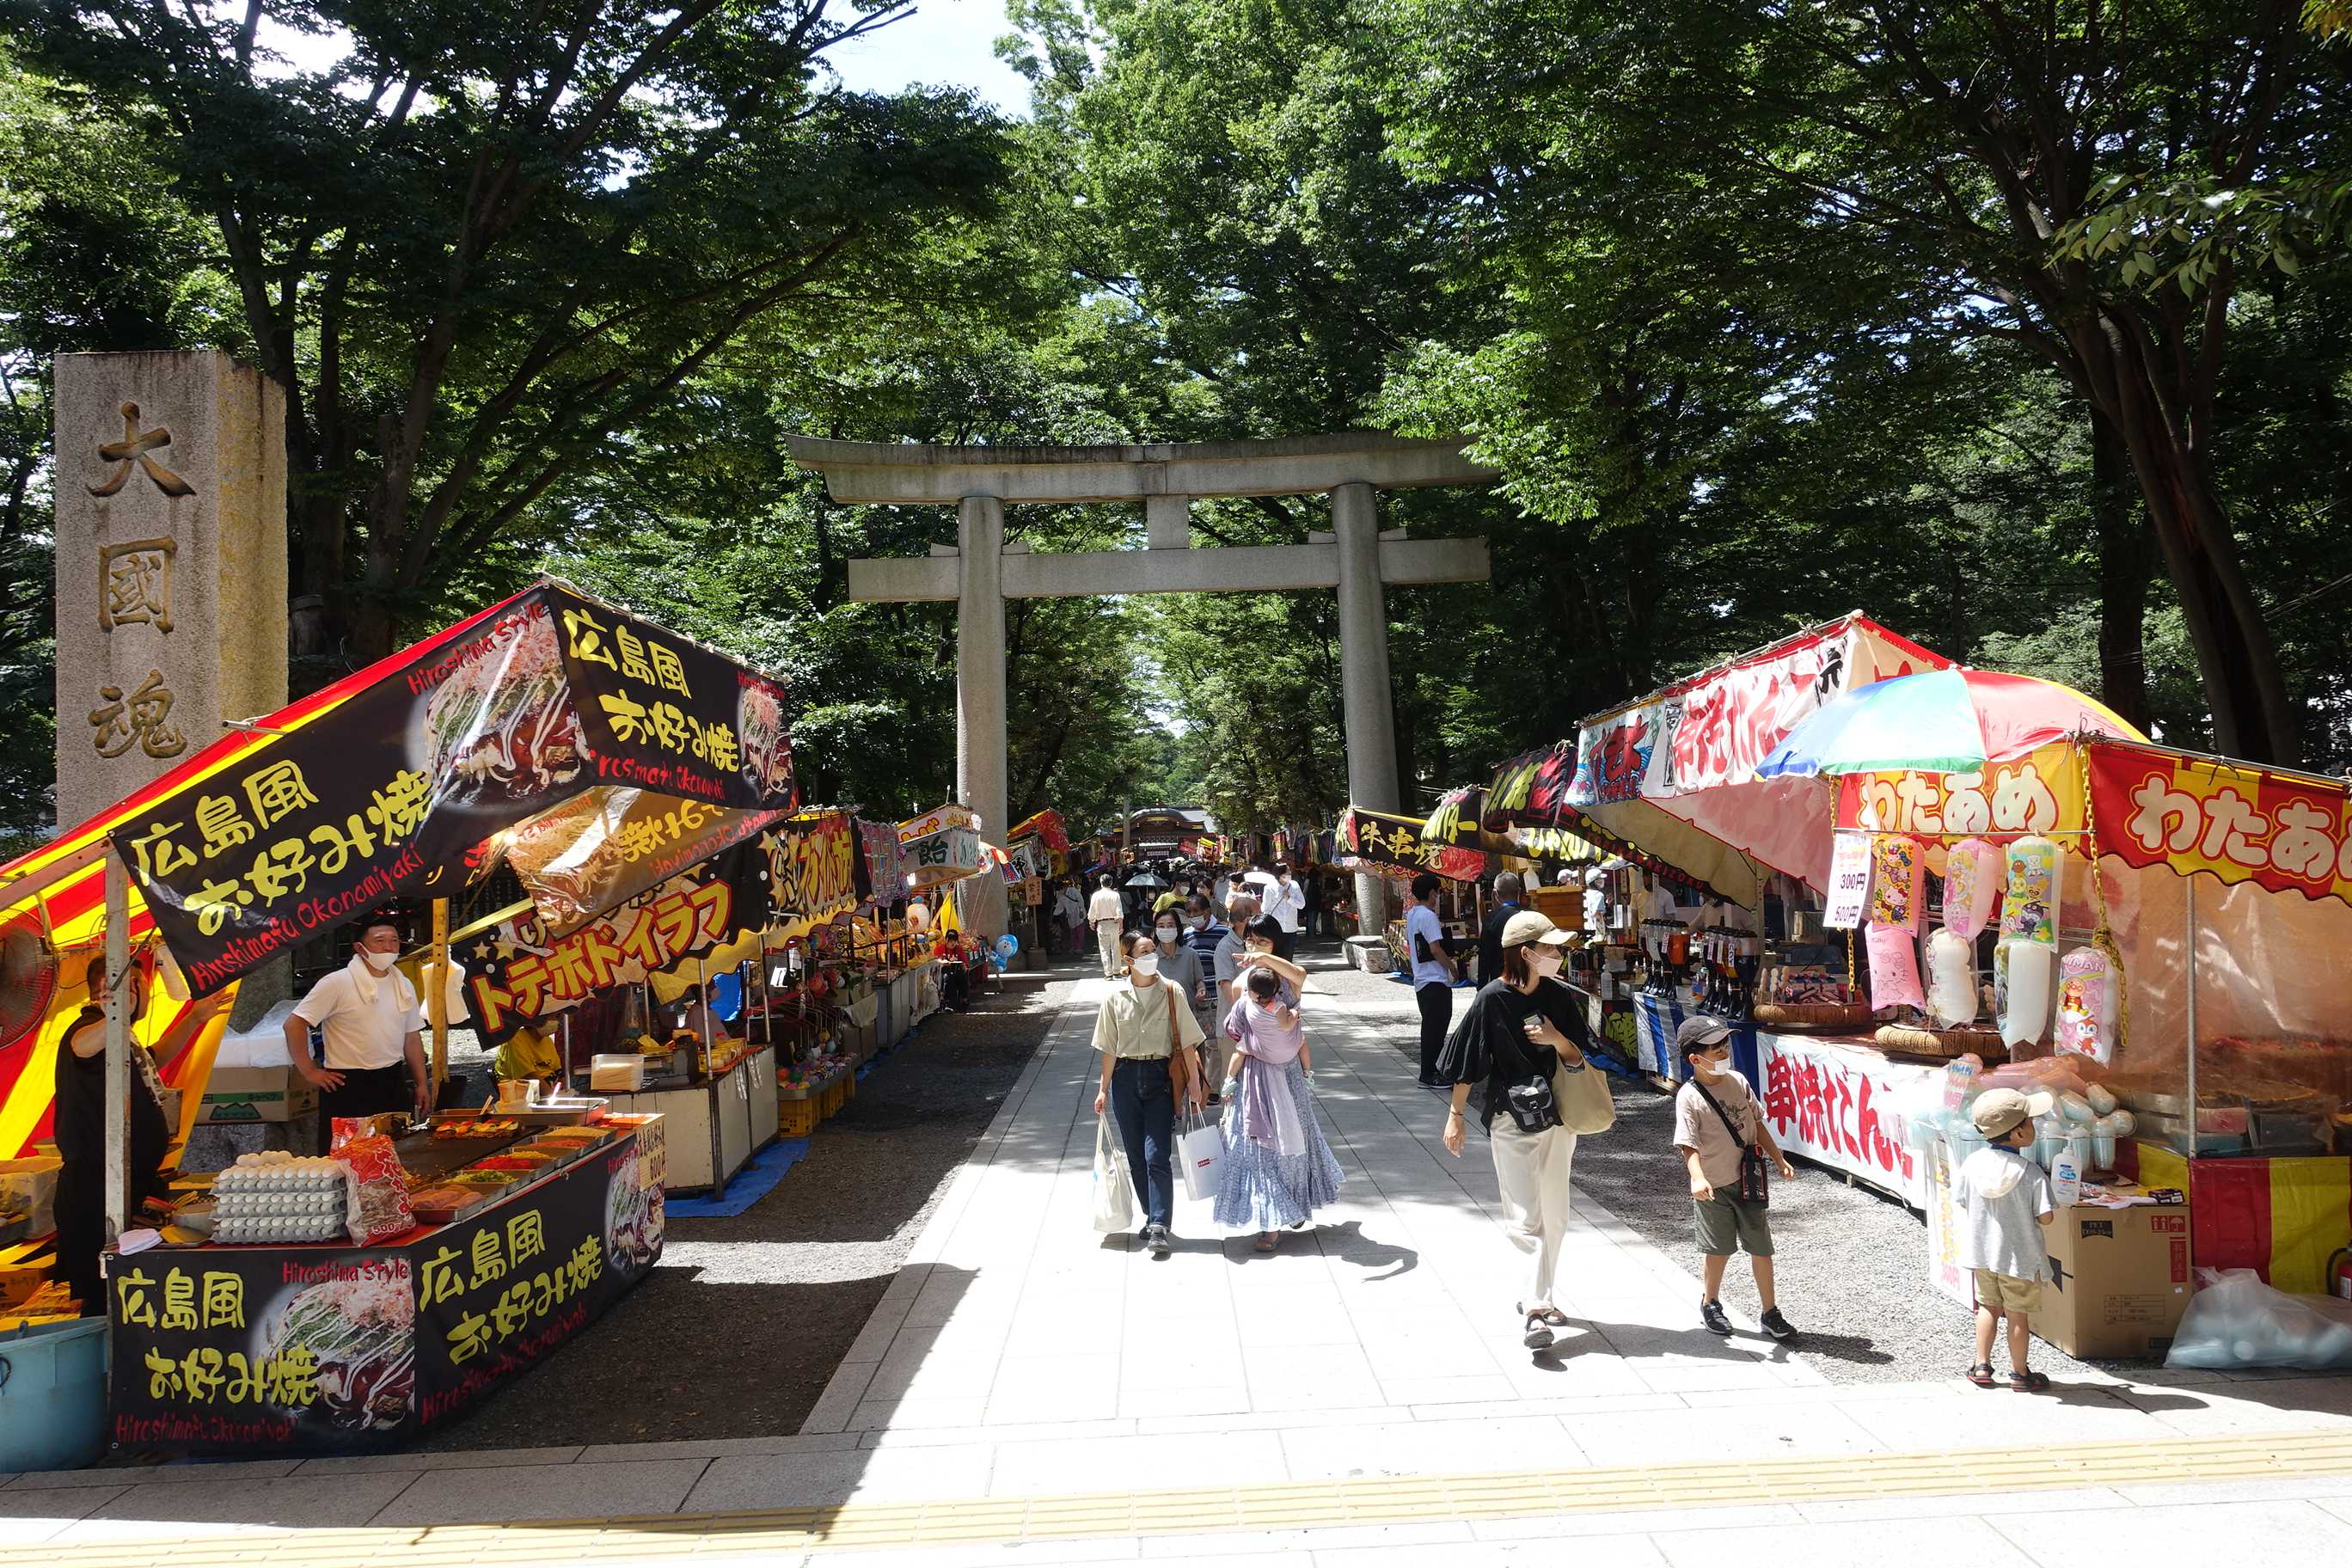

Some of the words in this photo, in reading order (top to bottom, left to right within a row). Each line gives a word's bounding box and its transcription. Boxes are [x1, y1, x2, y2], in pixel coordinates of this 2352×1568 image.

[407, 637, 496, 695] Hiroshima
[494, 603, 550, 643] Style
[563, 609, 691, 699] 広島風
[599, 689, 739, 772] お好み焼
[132, 759, 319, 886] 広島風
[1859, 764, 2057, 833] わたあめ
[2131, 776, 2352, 879] わたあ
[184, 769, 434, 935] お好み焼
[1841, 873, 1866, 891] 300円
[189, 916, 299, 989] Hiroshimafu
[297, 842, 425, 929] Okonomiyaki
[1834, 905, 1859, 923] 500円
[118, 1267, 245, 1331] 広島風
[282, 1261, 359, 1283] Hiroshima
[363, 1259, 409, 1281] Style
[420, 1210, 546, 1312] 広島風
[446, 1234, 603, 1365] お好み焼
[145, 1344, 318, 1405] お好み焼
